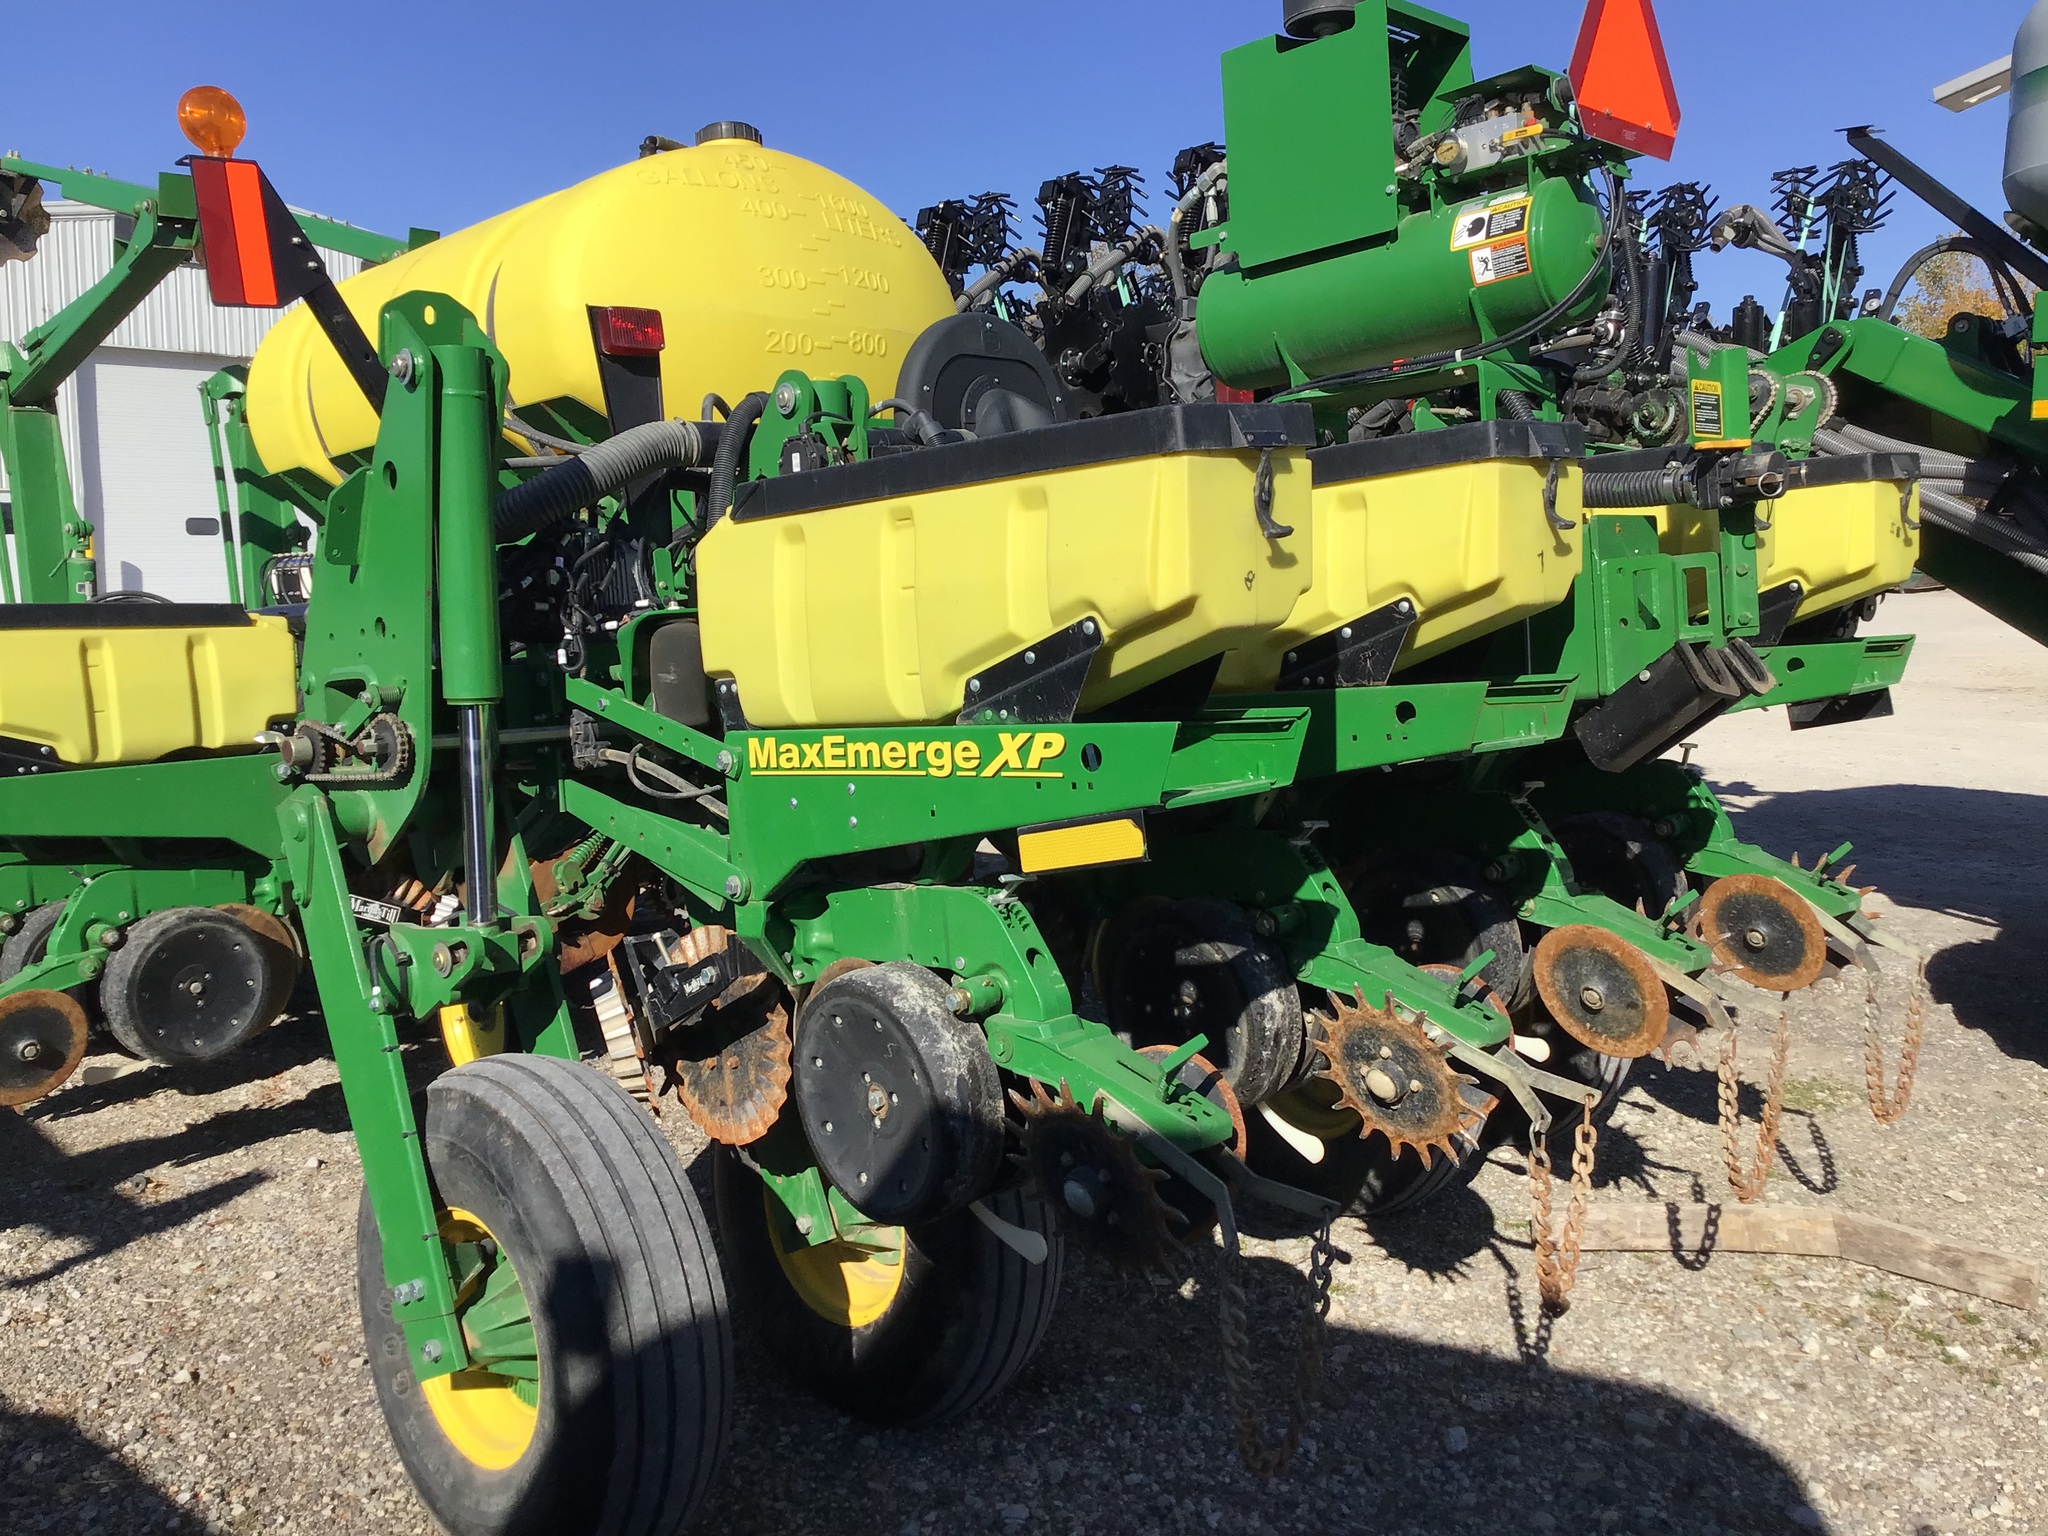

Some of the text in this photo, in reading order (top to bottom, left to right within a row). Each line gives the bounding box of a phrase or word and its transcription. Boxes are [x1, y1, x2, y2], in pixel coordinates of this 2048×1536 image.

[724, 153, 769, 172] 450
[636, 168, 779, 194] GALLONS
[742, 192, 869, 220] 400 1600
[821, 210, 902, 248] LITERS
[758, 265, 889, 294] 300 1200
[766, 329, 888, 358] 200 800
[1699, 382, 1718, 392] CAUTION
[747, 732, 1066, 778] MaxEmerge XP
